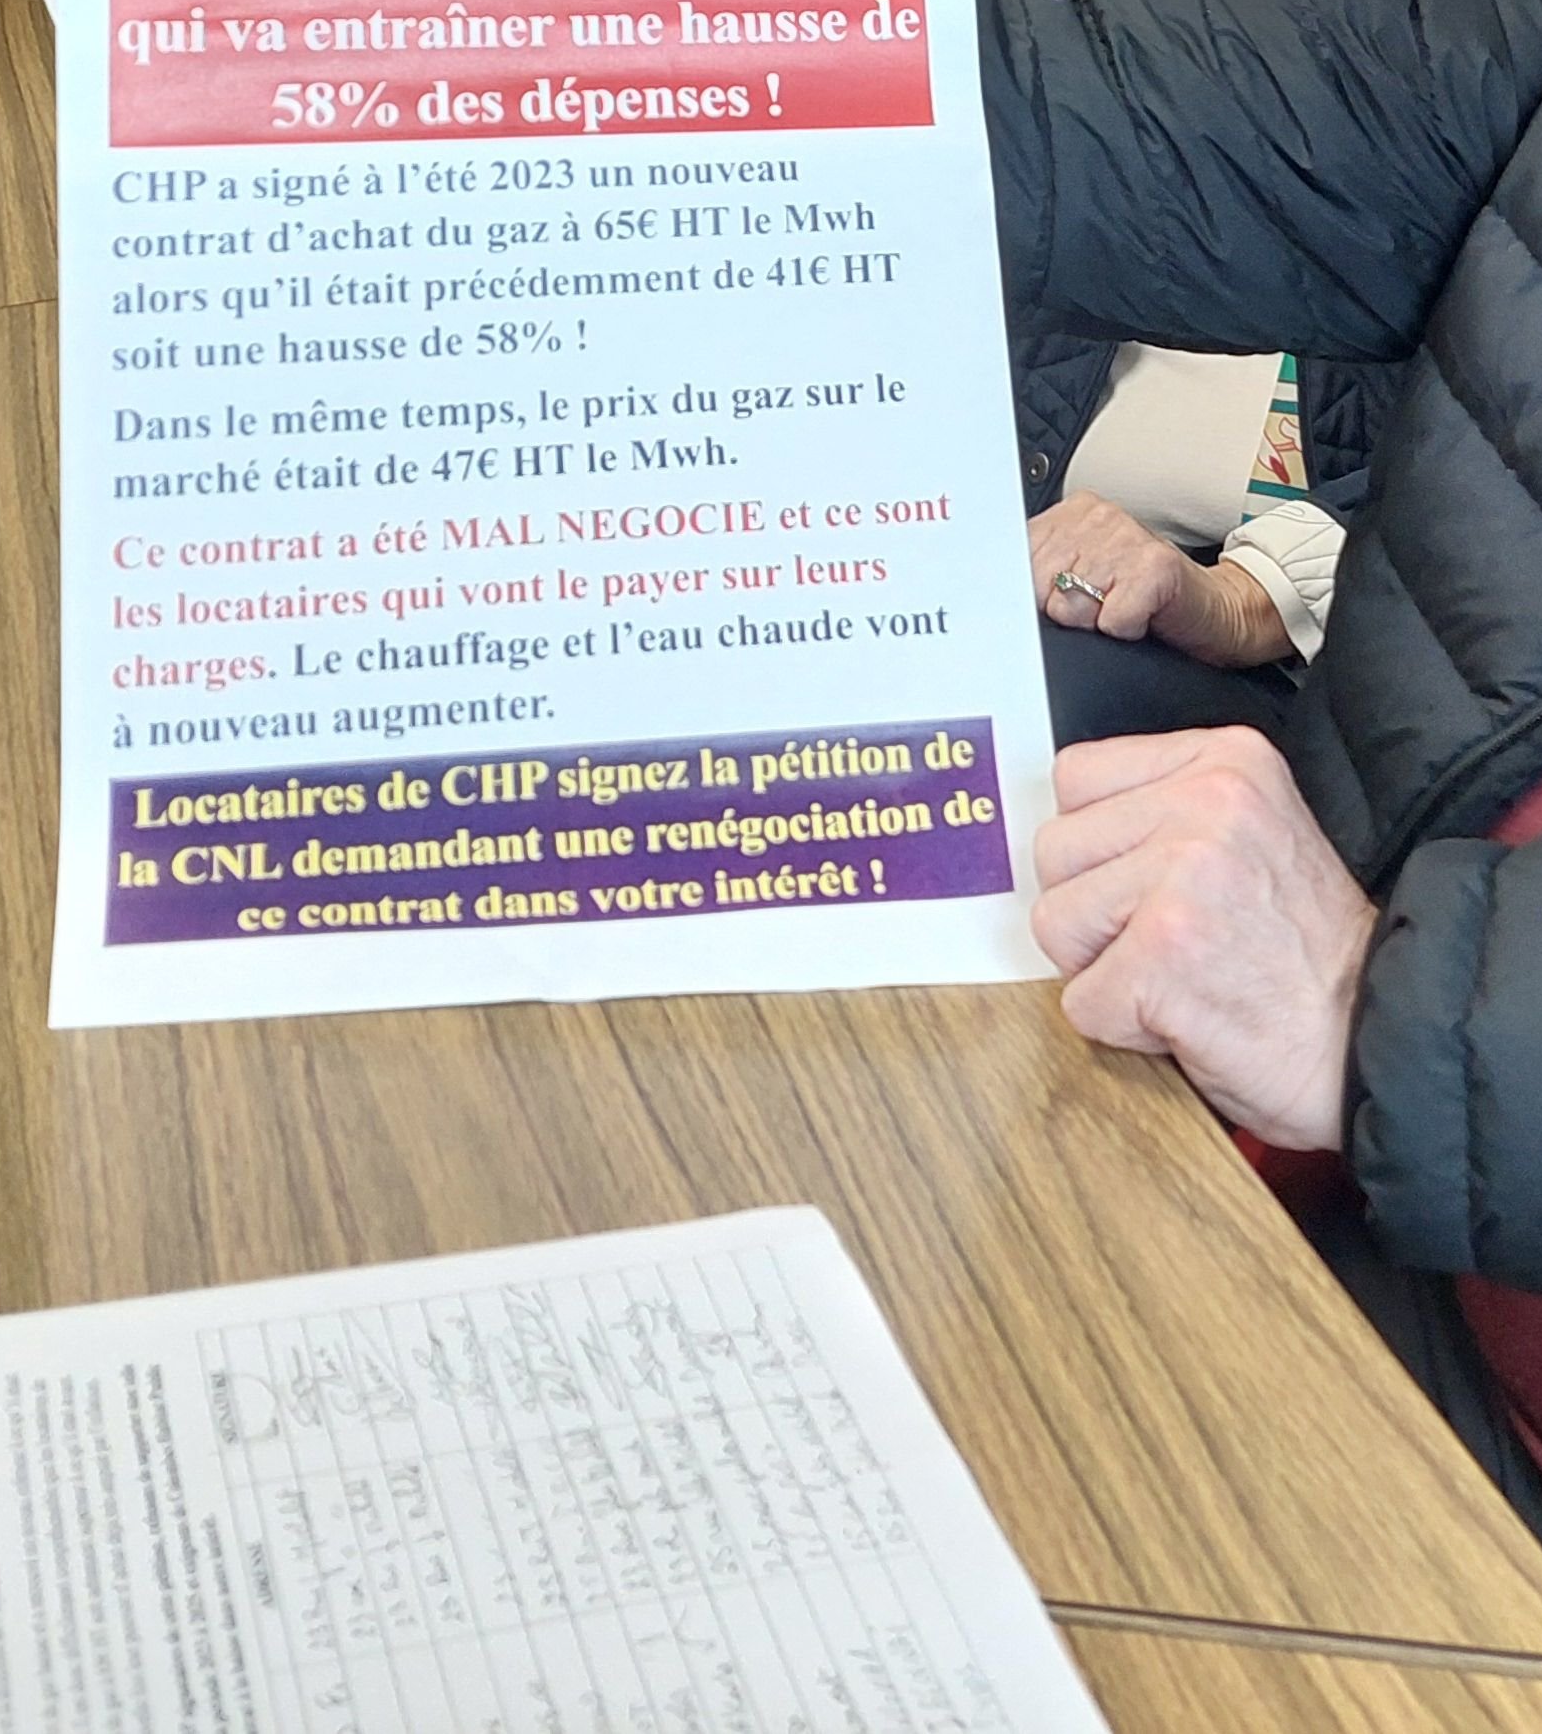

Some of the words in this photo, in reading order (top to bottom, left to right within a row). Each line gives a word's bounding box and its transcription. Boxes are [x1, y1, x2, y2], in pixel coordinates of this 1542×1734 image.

[117, 7, 206, 66] qui
[223, 19, 287, 52] va
[303, 2, 555, 51] entraîner
[570, 14, 664, 48] une
[678, 1, 848, 45] hausse
[271, 81, 399, 129] 58%
[417, 80, 504, 126] des
[520, 76, 750, 133] dépenses
[766, 72, 782, 117] !
[112, 170, 207, 204] CHP
[218, 178, 238, 200] a
[252, 164, 350, 207] signé
[364, 163, 384, 196] à
[490, 158, 575, 191] 2023
[589, 165, 634, 188] un
[648, 160, 799, 186] nouveau
[112, 228, 253, 259] contrat
[426, 216, 472, 247] du
[487, 221, 549, 254] gaz
[562, 211, 581, 242] à
[594, 208, 657, 241] 65€
[672, 206, 730, 238] HT
[742, 205, 771, 235] le
[785, 201, 875, 232] Mwh
[113, 282, 208, 315] alors
[326, 273, 409, 306] était
[424, 265, 700, 312] précédemment
[713, 259, 754, 290] de
[766, 255, 829, 287] 41€
[844, 252, 901, 284] HT
[112, 337, 179, 370] soit
[195, 343, 264, 368] une
[279, 332, 407, 364] hausse
[420, 325, 463, 358] de
[476, 320, 562, 356] 58%
[577, 319, 587, 351] !
[115, 409, 211, 442] Dans
[226, 404, 257, 437] le
[272, 399, 388, 435] même
[401, 401, 526, 434] temps,
[539, 390, 569, 421] le
[583, 385, 658, 428] prix
[672, 383, 717, 414] du
[731, 387, 794, 420] gaz
[806, 383, 864, 407] sur
[875, 373, 906, 403] le
[114, 459, 260, 500] marché
[274, 456, 360, 491] était
[374, 453, 419, 486] de
[431, 448, 498, 482] 47€
[514, 443, 574, 477] HT
[587, 442, 617, 473] le
[632, 436, 738, 471] Mwh.
[113, 537, 165, 570] Ce
[179, 531, 323, 566] contrat
[338, 534, 358, 557] a
[372, 519, 427, 555] été
[443, 514, 545, 549] MAL
[558, 500, 765, 541] NEGOCIE
[779, 502, 810, 530] et
[825, 504, 862, 528] ce
[875, 494, 950, 524] sont
[114, 596, 163, 629] les
[178, 585, 368, 625] locataires
[381, 576, 444, 621] qui
[459, 575, 543, 606] vont
[558, 569, 588, 600] le
[603, 569, 710, 607] payer
[722, 564, 782, 590] sur
[794, 554, 887, 586] leurs
[112, 654, 277, 691] charges.
[294, 643, 342, 677] Le
[356, 631, 549, 673] chauffage
[563, 629, 595, 658] et
[718, 609, 853, 648] chaude
[866, 607, 948, 637] vont
[113, 714, 133, 749] à
[149, 711, 317, 746] nouveau
[333, 693, 555, 739] augmenter.
[134, 777, 367, 829] Locataires
[377, 770, 430, 811] de
[441, 760, 549, 806] CHP
[557, 756, 690, 805] signez
[700, 748, 740, 787] la
[751, 737, 912, 794] pétition
[924, 731, 974, 770] de
[117, 851, 160, 888] la
[171, 842, 283, 885] CNL
[292, 827, 543, 878] demandant
[554, 826, 634, 859] une
[646, 798, 934, 856] renégociation
[943, 790, 995, 827] de
[237, 906, 287, 932] ce
[291, 892, 466, 937] contrat
[474, 886, 579, 921] dans
[585, 879, 708, 922] votre
[710, 861, 863, 914] intérêt
[870, 859, 886, 894] !
